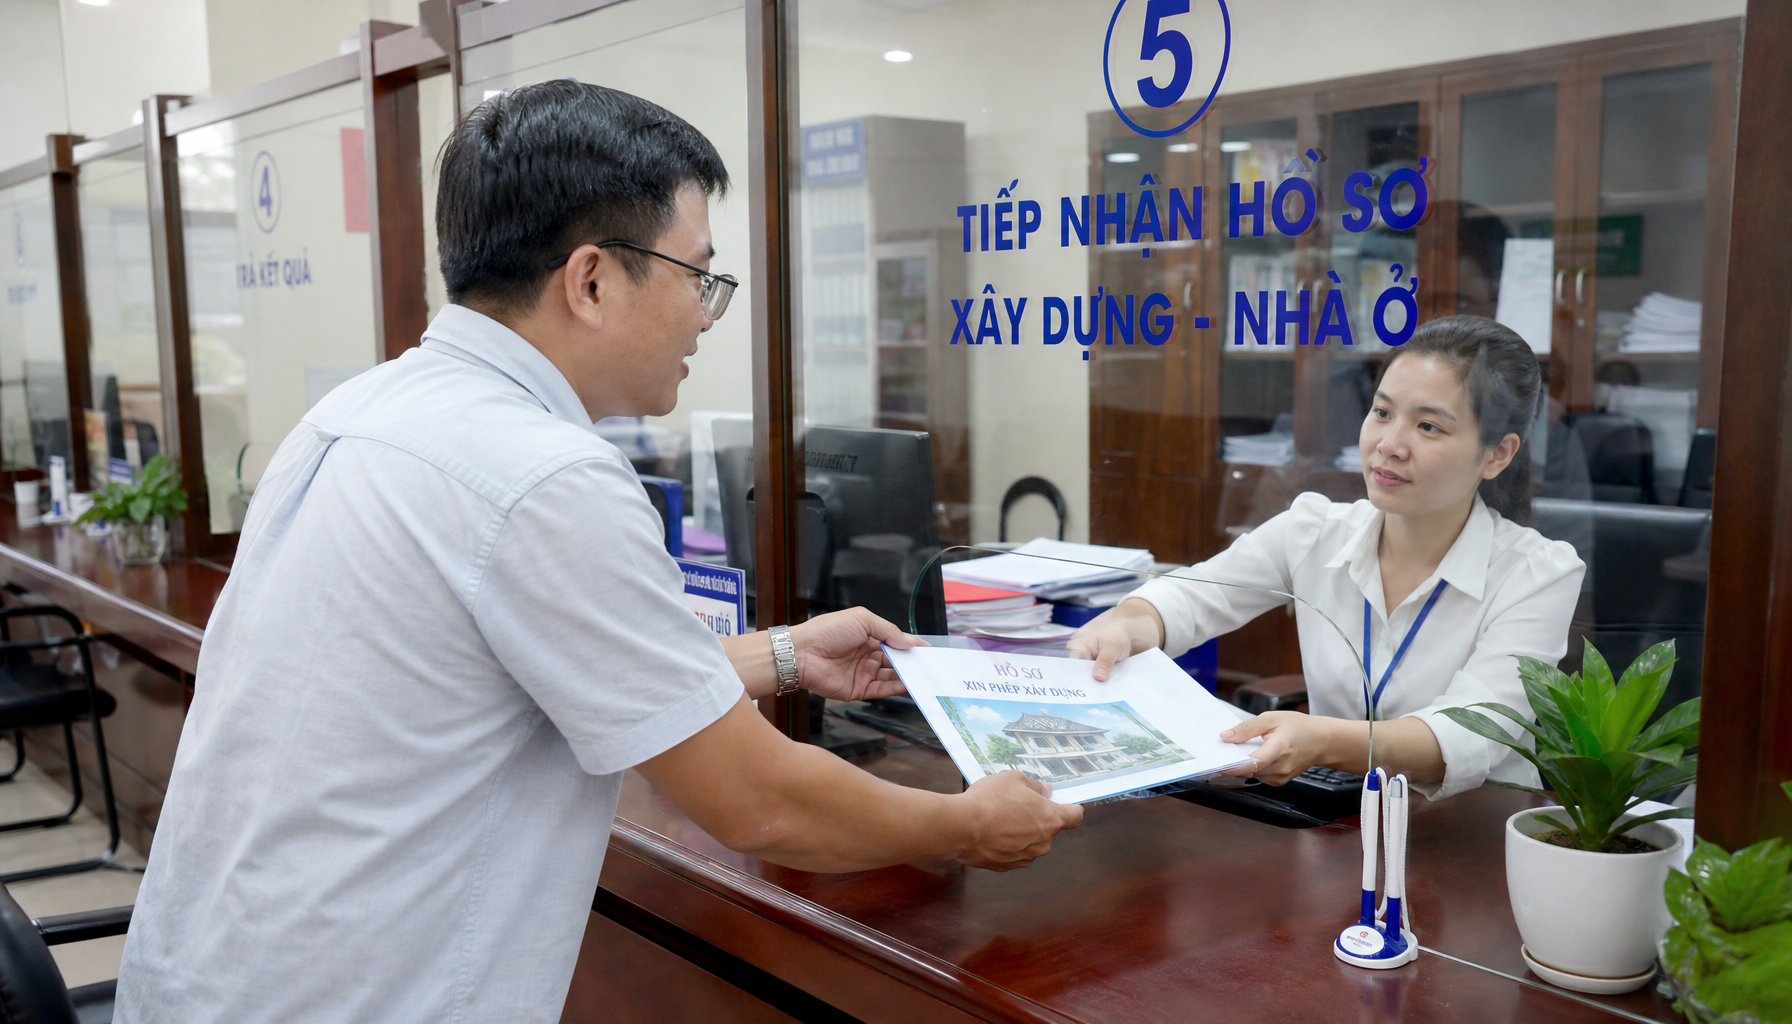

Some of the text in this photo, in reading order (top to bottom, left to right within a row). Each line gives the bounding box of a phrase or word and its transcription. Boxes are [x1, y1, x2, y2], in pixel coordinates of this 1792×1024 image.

[1137, 0, 1193, 109] 5
[259, 165, 274, 218] 4
[956, 148, 1429, 258] TIẾP NHẬN HỒ SƠ
[949, 263, 1419, 361] XÂY DỰNG - NHÀ Ở
[962, 680, 987, 692] XIN
[1020, 667, 1043, 680] SƠ
